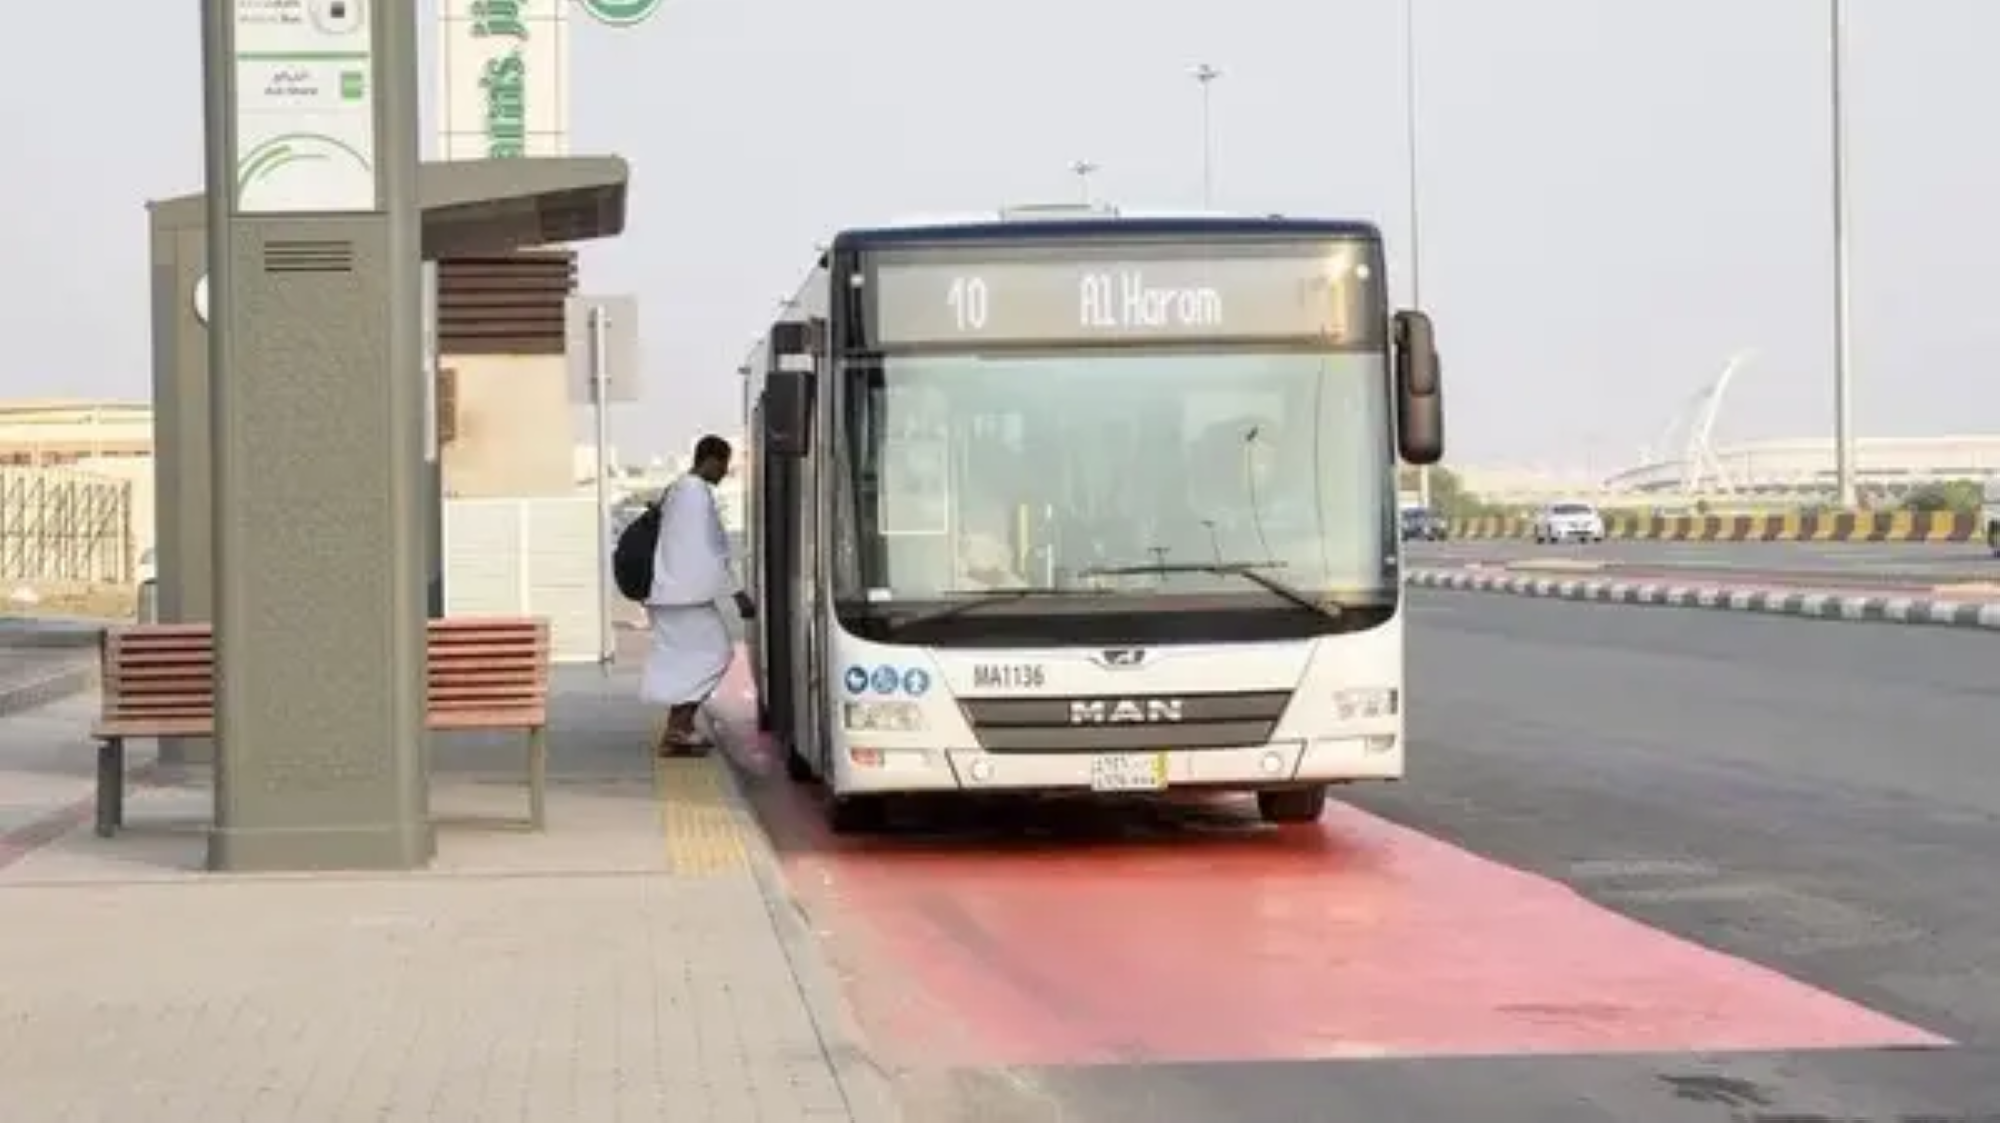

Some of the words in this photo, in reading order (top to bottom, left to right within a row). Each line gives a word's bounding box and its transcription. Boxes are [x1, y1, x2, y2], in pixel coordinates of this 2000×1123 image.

[947, 276, 988, 331] 10
[973, 663, 1046, 688] MA1136
[1069, 699, 1184, 723] MAN
